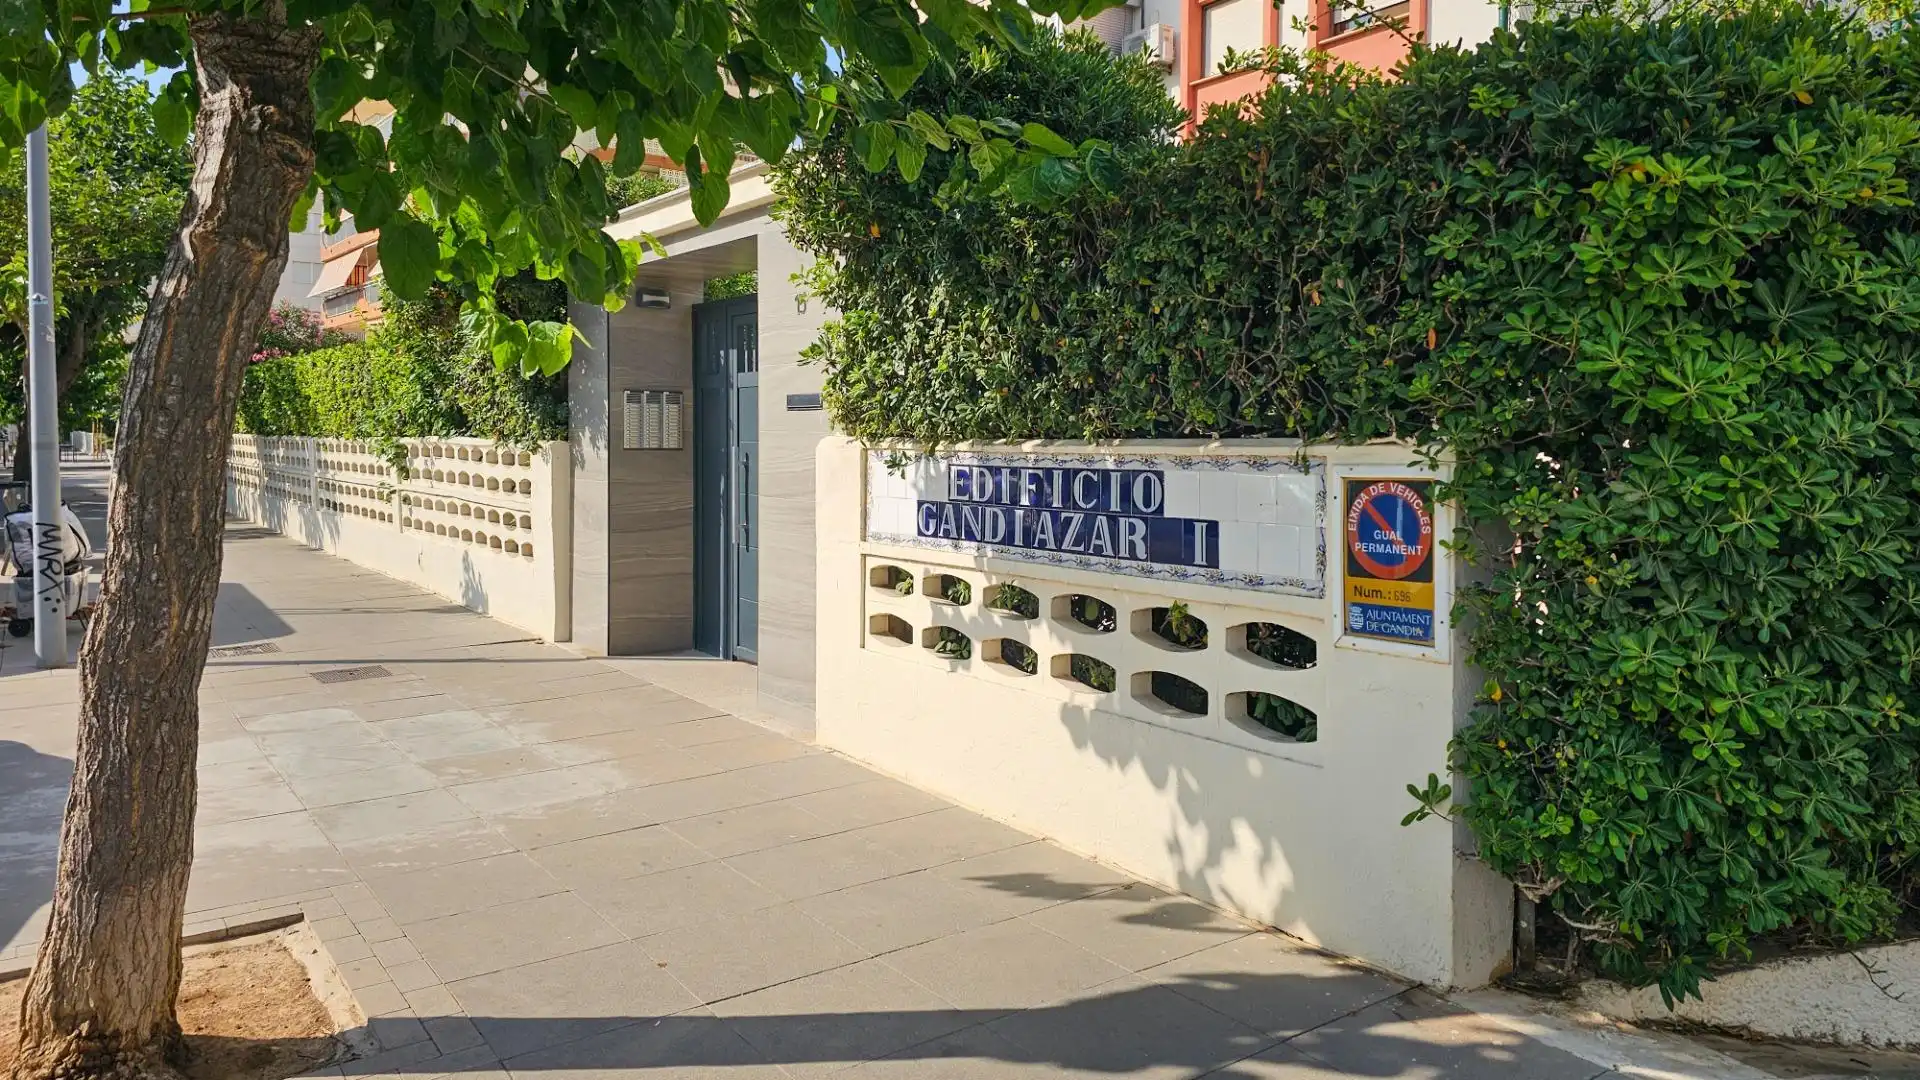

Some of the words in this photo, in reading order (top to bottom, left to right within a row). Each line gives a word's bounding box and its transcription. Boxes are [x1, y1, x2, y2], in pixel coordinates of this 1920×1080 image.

[950, 465, 1163, 513] EDIFICIO
[1348, 493, 1369, 531] EIXIDA
[1370, 482, 1386, 495] DE
[918, 502, 1148, 561] GANDIAZAR
[1192, 521, 1209, 566] I
[1373, 530, 1403, 541] GUAL
[1354, 543, 1423, 556] PERMANENT
[1353, 584, 1392, 600] Num.:
[1366, 608, 1432, 625] AJUNTAMENT
[1366, 621, 1380, 632] DE
[1381, 623, 1424, 637] GANDIA
